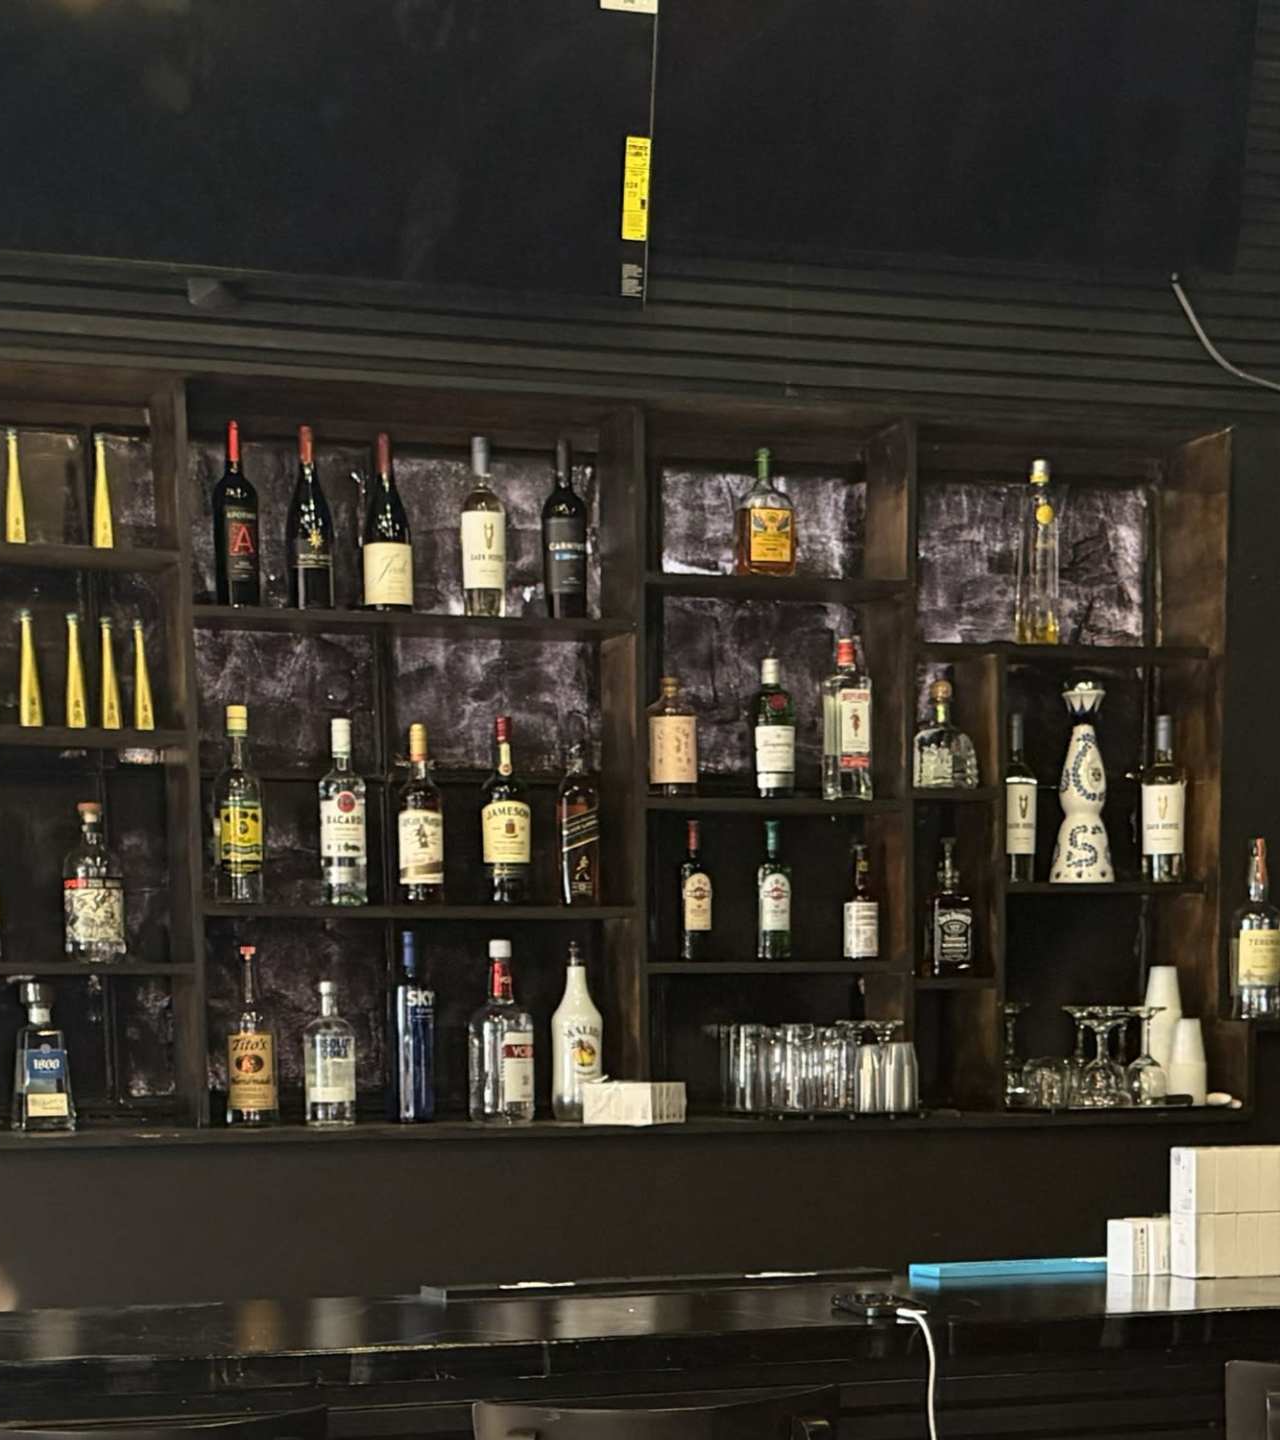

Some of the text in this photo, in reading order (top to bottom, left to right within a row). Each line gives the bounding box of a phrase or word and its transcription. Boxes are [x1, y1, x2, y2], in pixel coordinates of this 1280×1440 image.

[486, 806, 529, 821] JAMESON
[231, 1038, 268, 1051] Tito's
[33, 1058, 61, 1070] 1800
